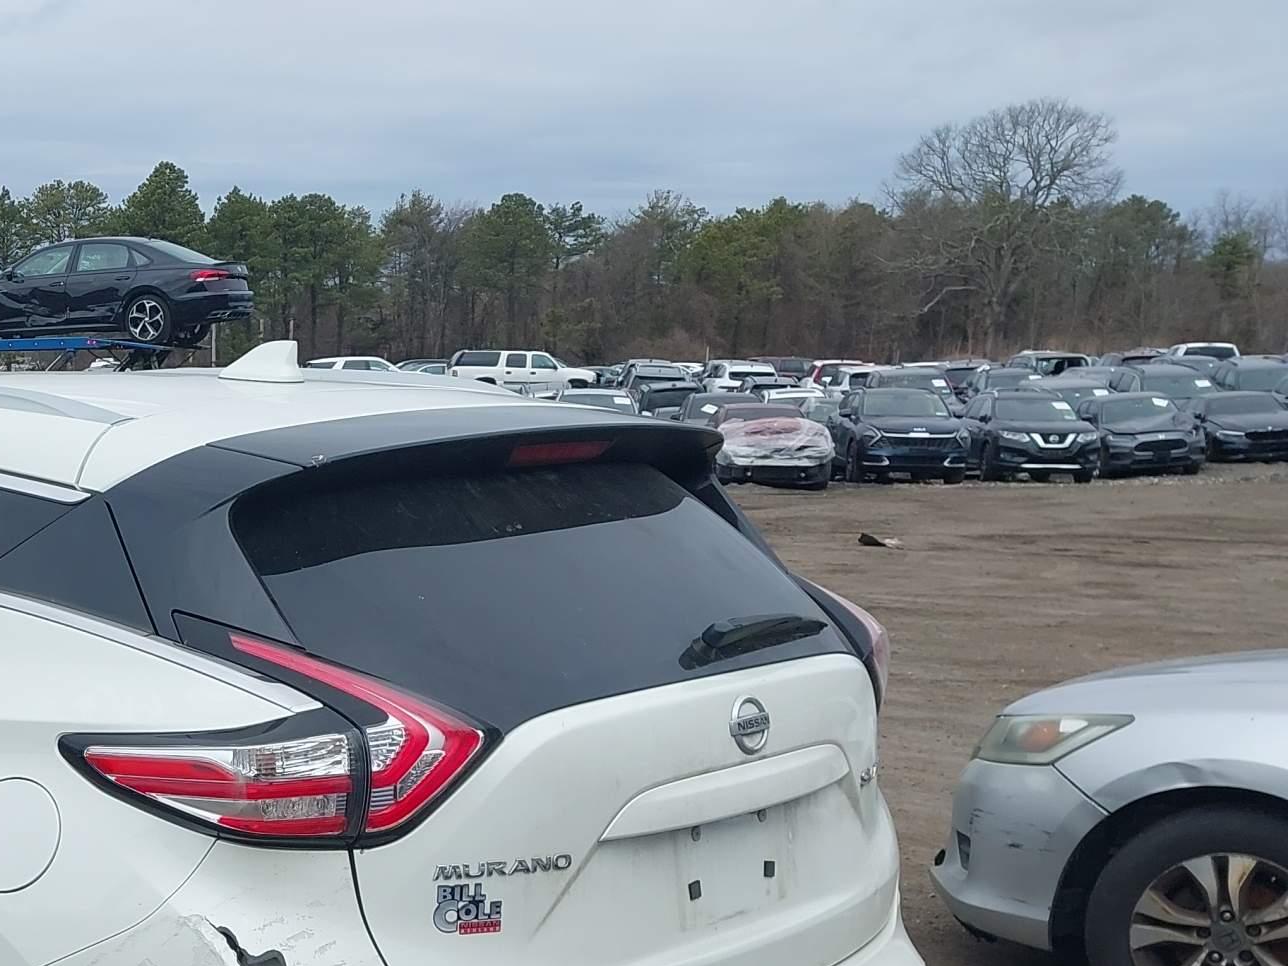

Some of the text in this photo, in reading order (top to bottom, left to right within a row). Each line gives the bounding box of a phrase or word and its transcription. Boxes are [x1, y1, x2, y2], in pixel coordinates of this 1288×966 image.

[737, 714, 770, 731] NISSAN
[433, 853, 572, 881] MURANO
[437, 883, 486, 903] BILL
[433, 900, 502, 933] COLE
